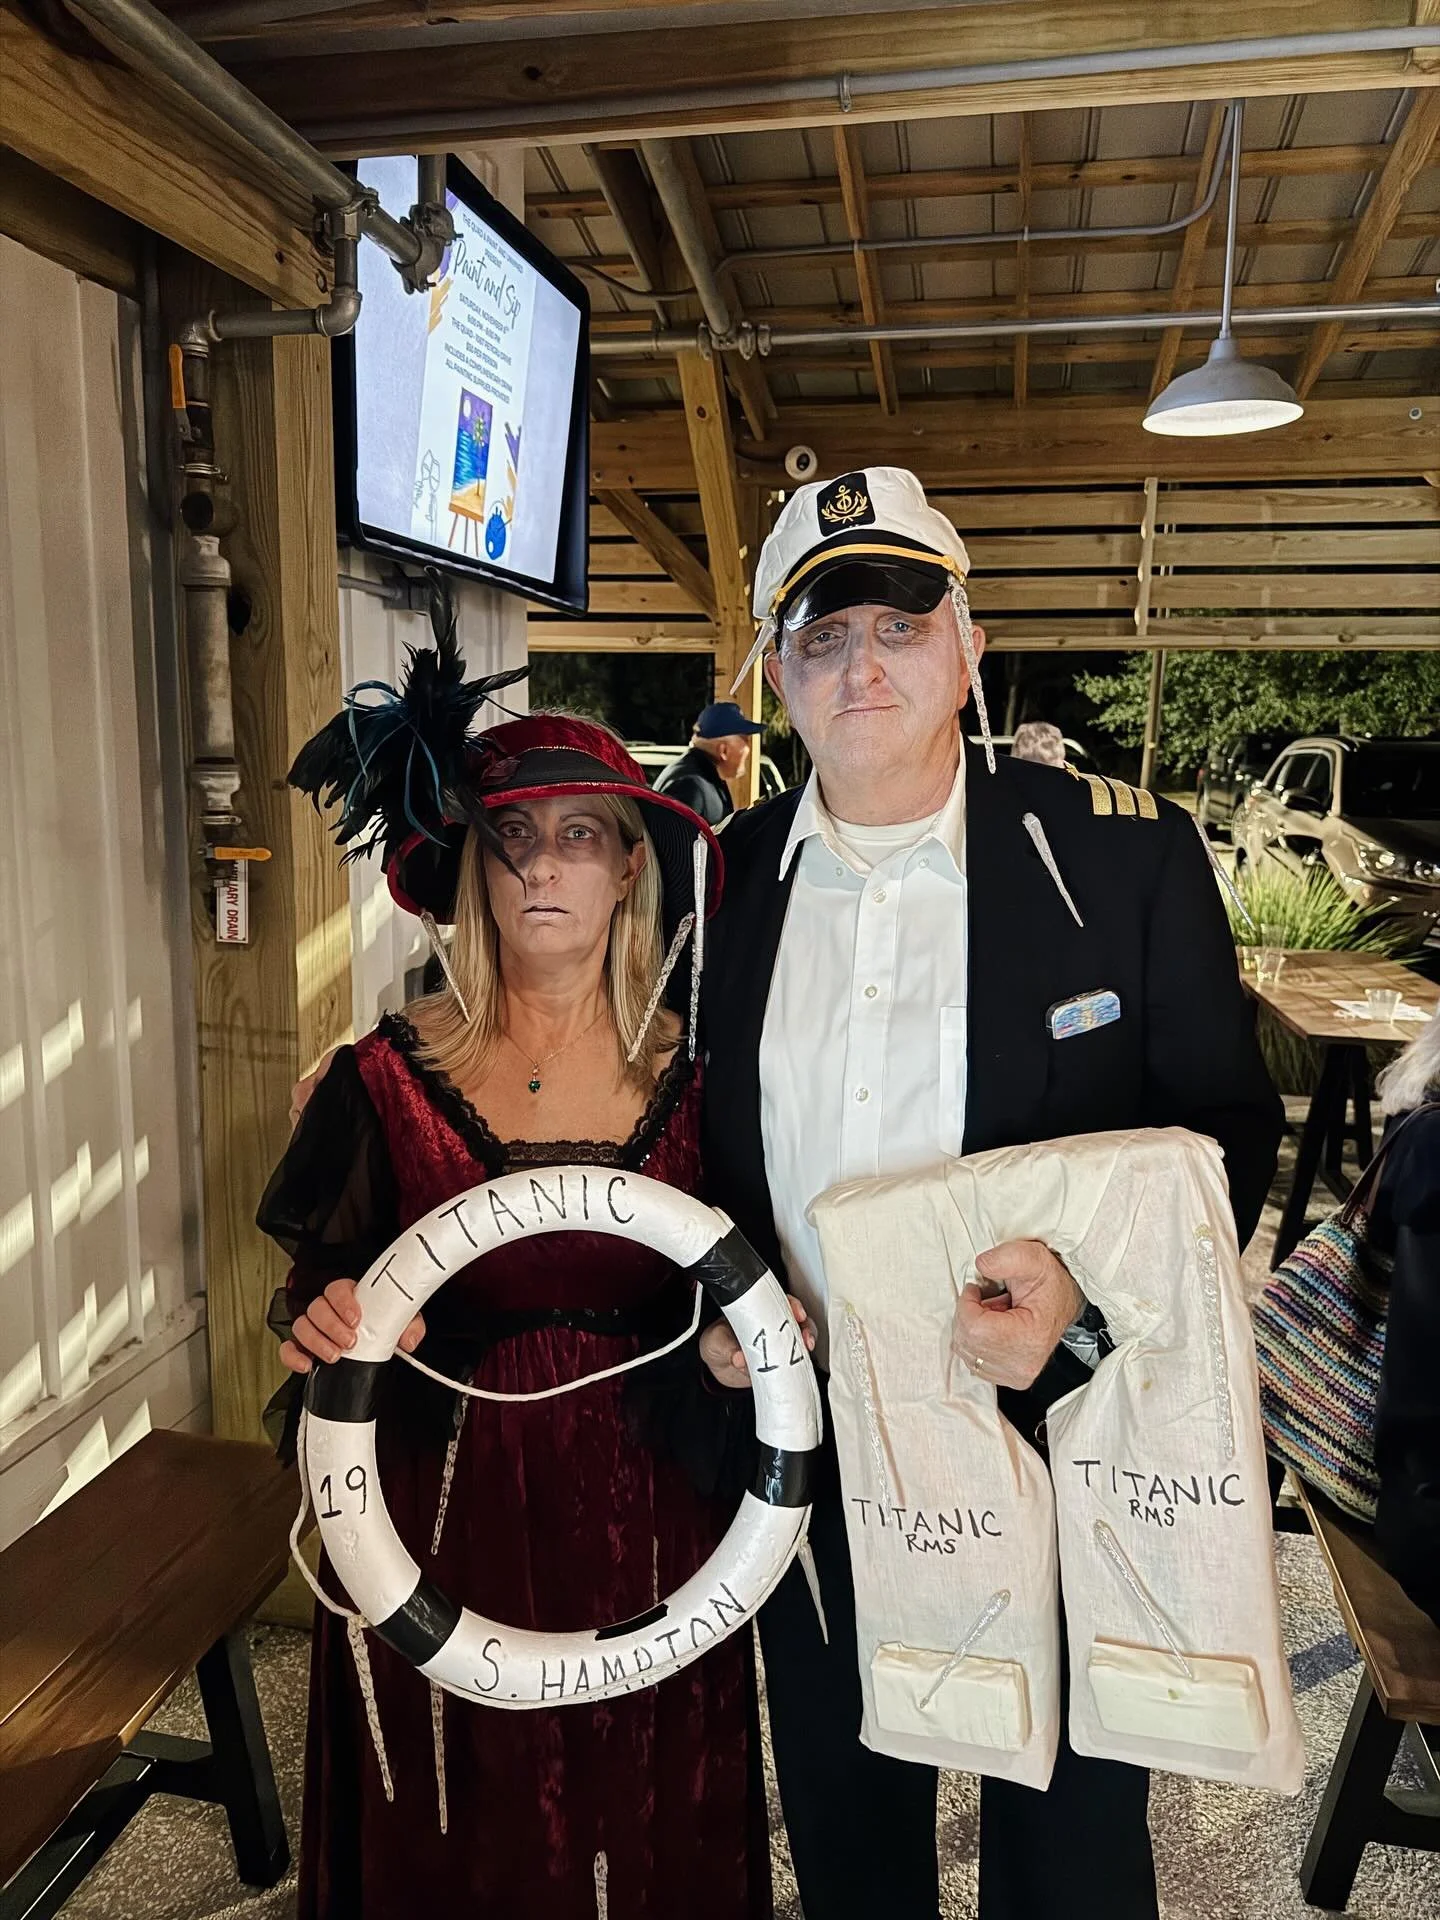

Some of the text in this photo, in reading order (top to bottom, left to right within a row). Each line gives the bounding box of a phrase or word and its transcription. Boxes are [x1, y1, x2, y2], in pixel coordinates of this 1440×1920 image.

[453, 239, 487, 290] Paint
[483, 274, 506, 309] and
[503, 284, 521, 330] Sip
[226, 908, 239, 940] DRAIN
[370, 1173, 635, 1302] TITANIC
[320, 1465, 367, 1519] 19
[1072, 1459, 1246, 1506] TITANIC
[851, 1498, 1003, 1539] TITANIC
[1128, 1498, 1176, 1529] RMS
[905, 1533, 957, 1555] RMS
